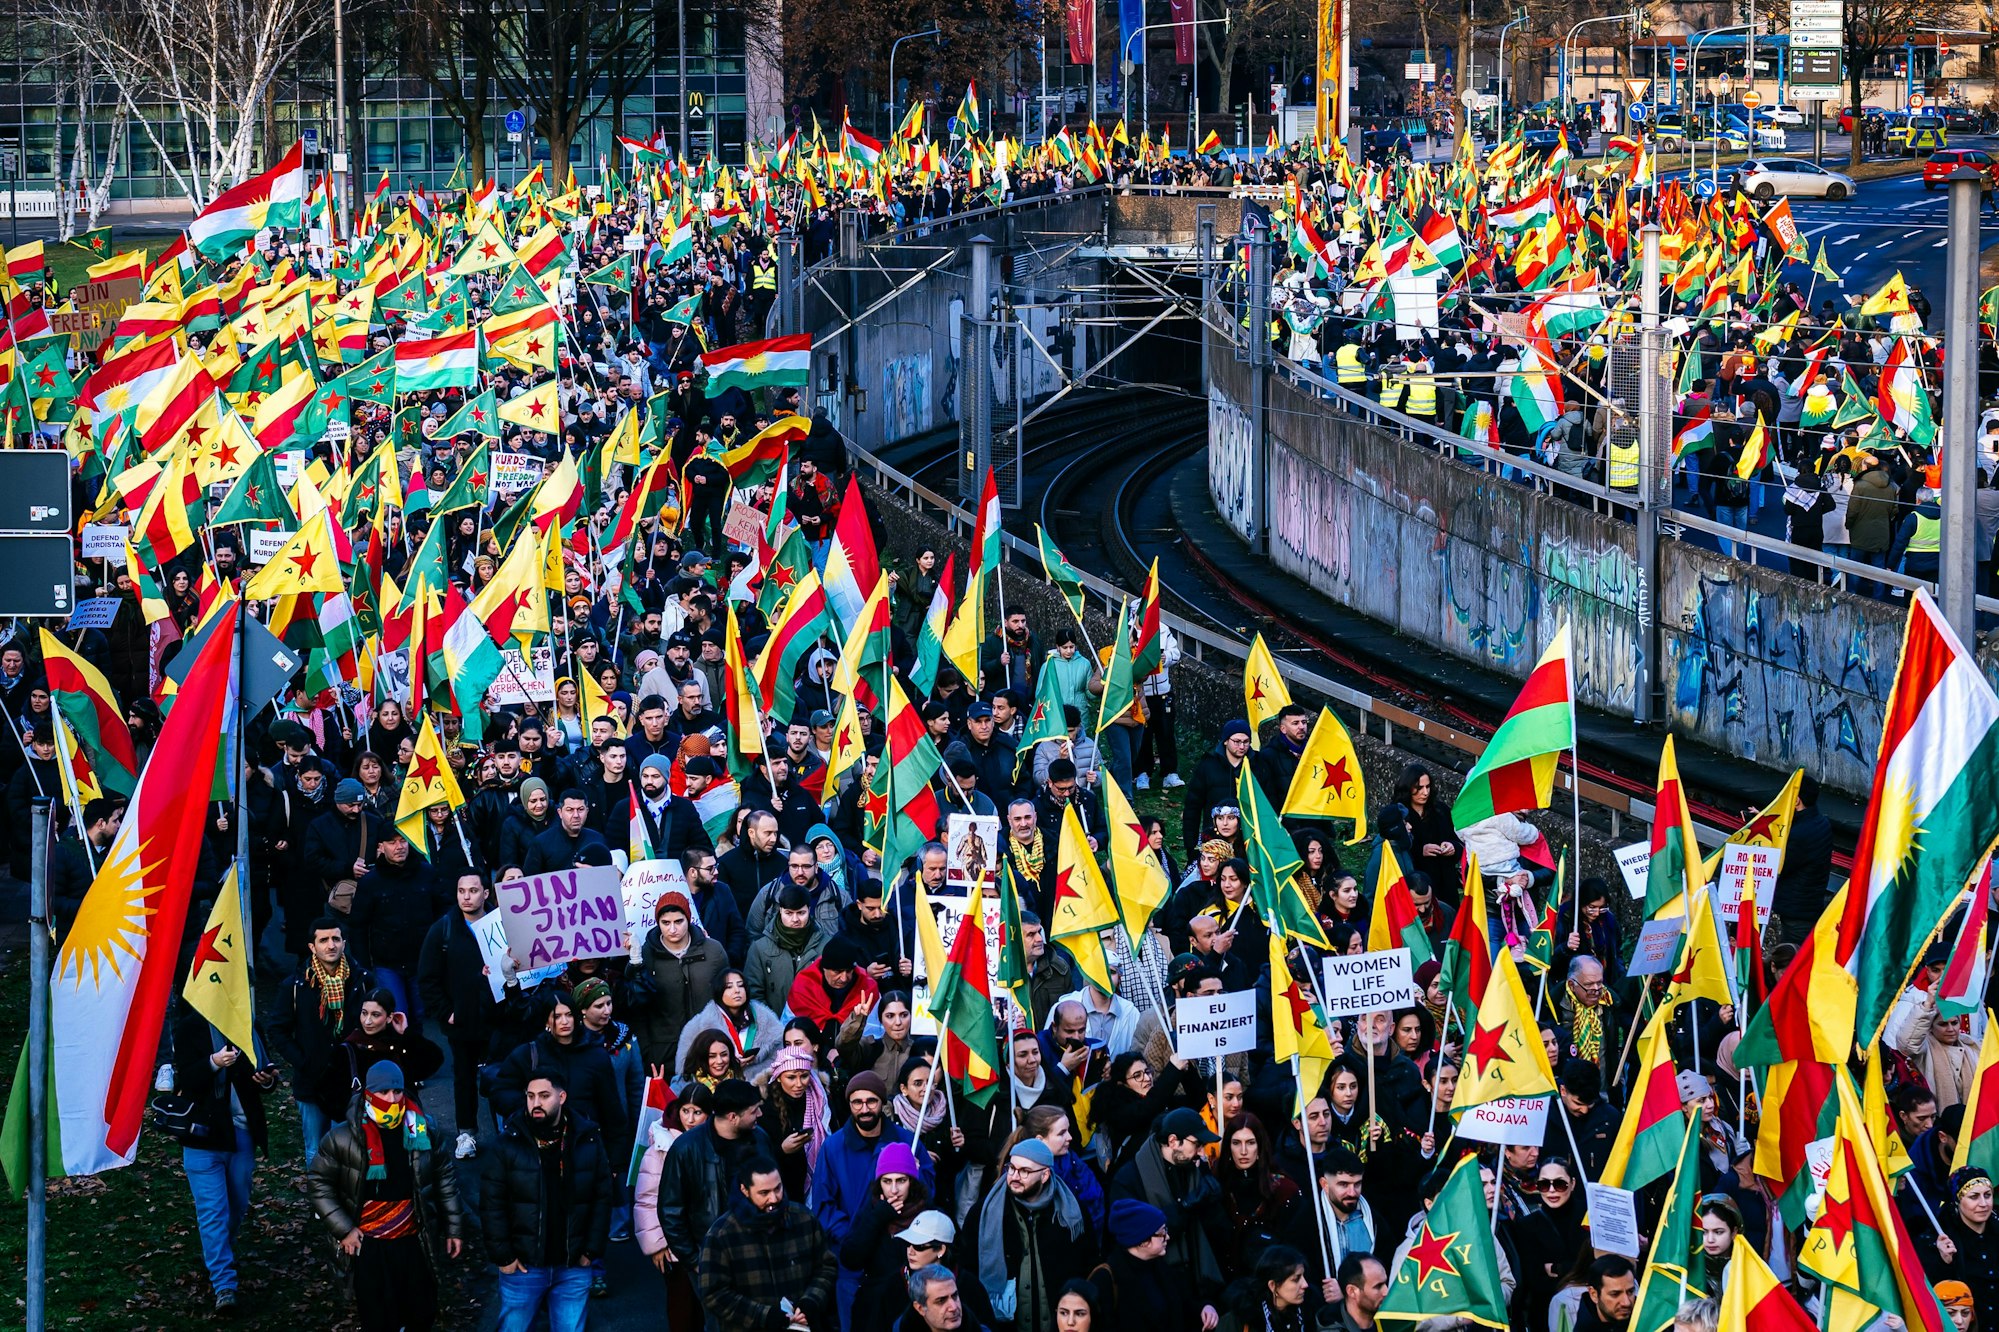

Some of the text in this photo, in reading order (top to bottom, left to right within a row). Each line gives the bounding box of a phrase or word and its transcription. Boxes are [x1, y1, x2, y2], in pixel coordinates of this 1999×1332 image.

[52, 313, 91, 332] FREE
[495, 454, 526, 465] KURDS
[497, 472, 535, 481] FREEDOM
[85, 541, 125, 549] KURDISTAN
[1312, 765, 1357, 804] Y P G
[1737, 852, 1767, 864] ROAVA
[502, 871, 577, 913] JIN
[531, 895, 618, 933] JIYAN
[529, 928, 621, 968] AZADI
[1536, 936, 1548, 949] P
[1333, 955, 1401, 976] WOMEN
[1353, 974, 1385, 991] LIFE
[1330, 988, 1410, 1011] FREEDOM
[1209, 1003, 1226, 1014] EU
[1178, 1014, 1254, 1035] FINANZIERT
[1215, 1037, 1227, 1047] IS
[1476, 1109, 1528, 1125] ROJAVA
[1812, 1236, 1827, 1254] P
